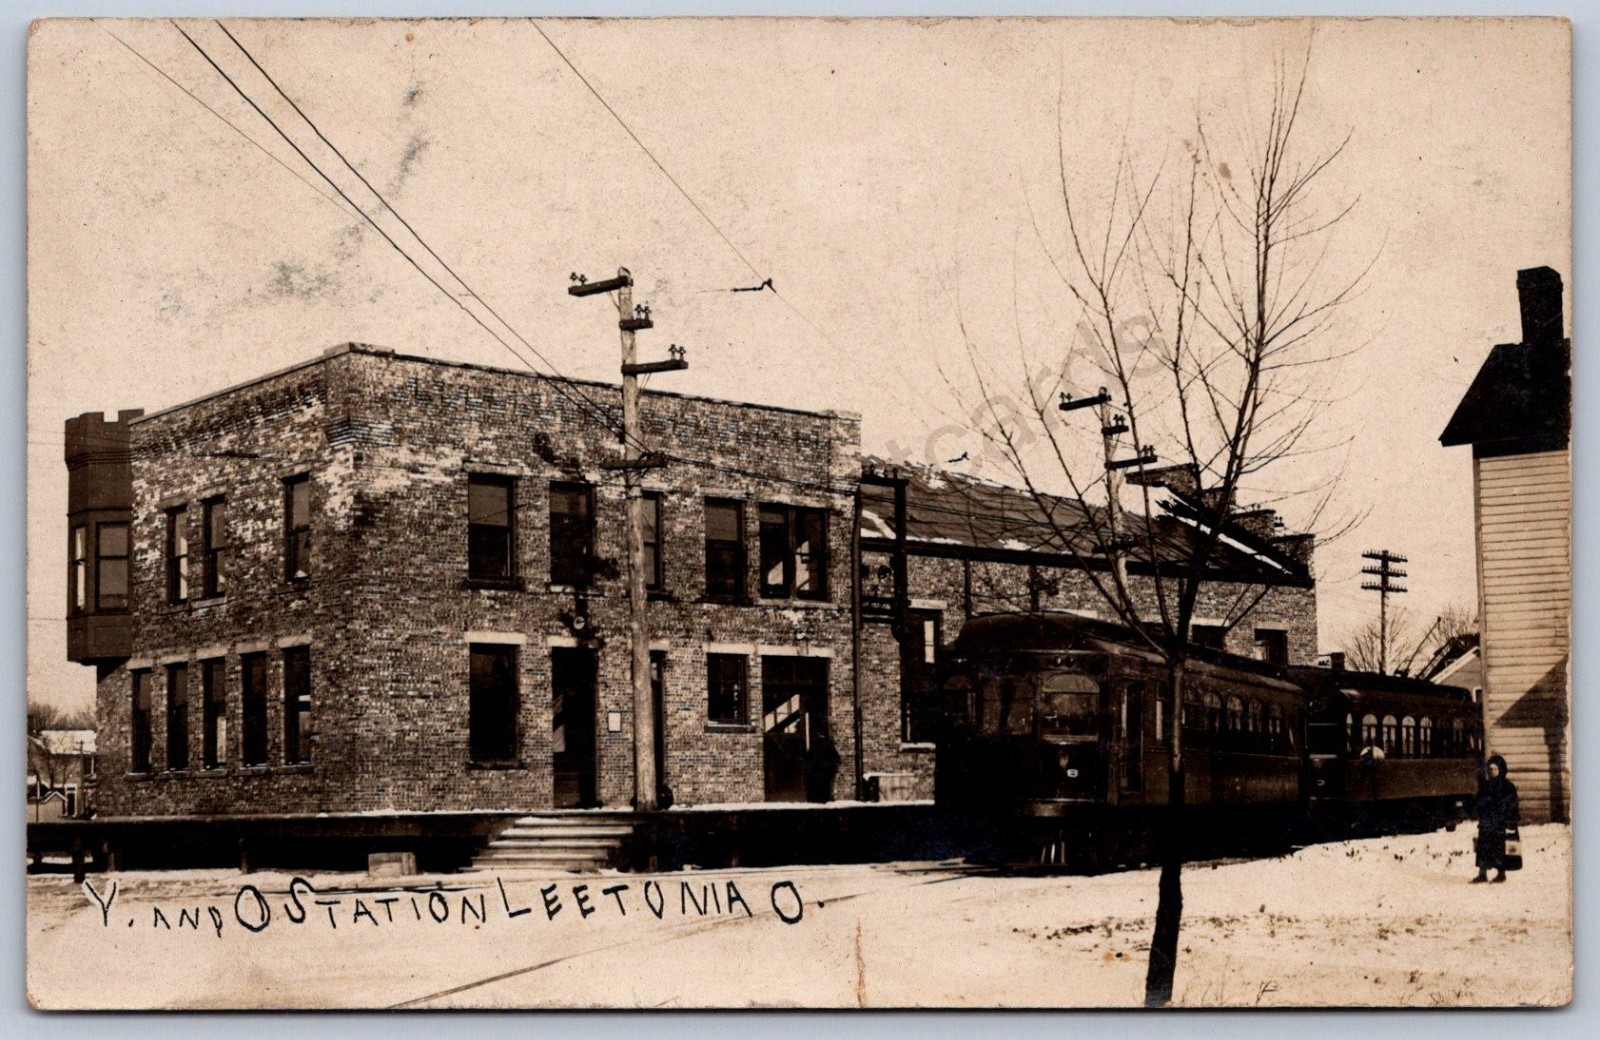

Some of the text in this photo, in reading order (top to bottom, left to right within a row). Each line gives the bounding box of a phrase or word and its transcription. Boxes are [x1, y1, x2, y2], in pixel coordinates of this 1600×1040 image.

[84, 875, 826, 938] Y. AND O STATION LEETONIA O.
